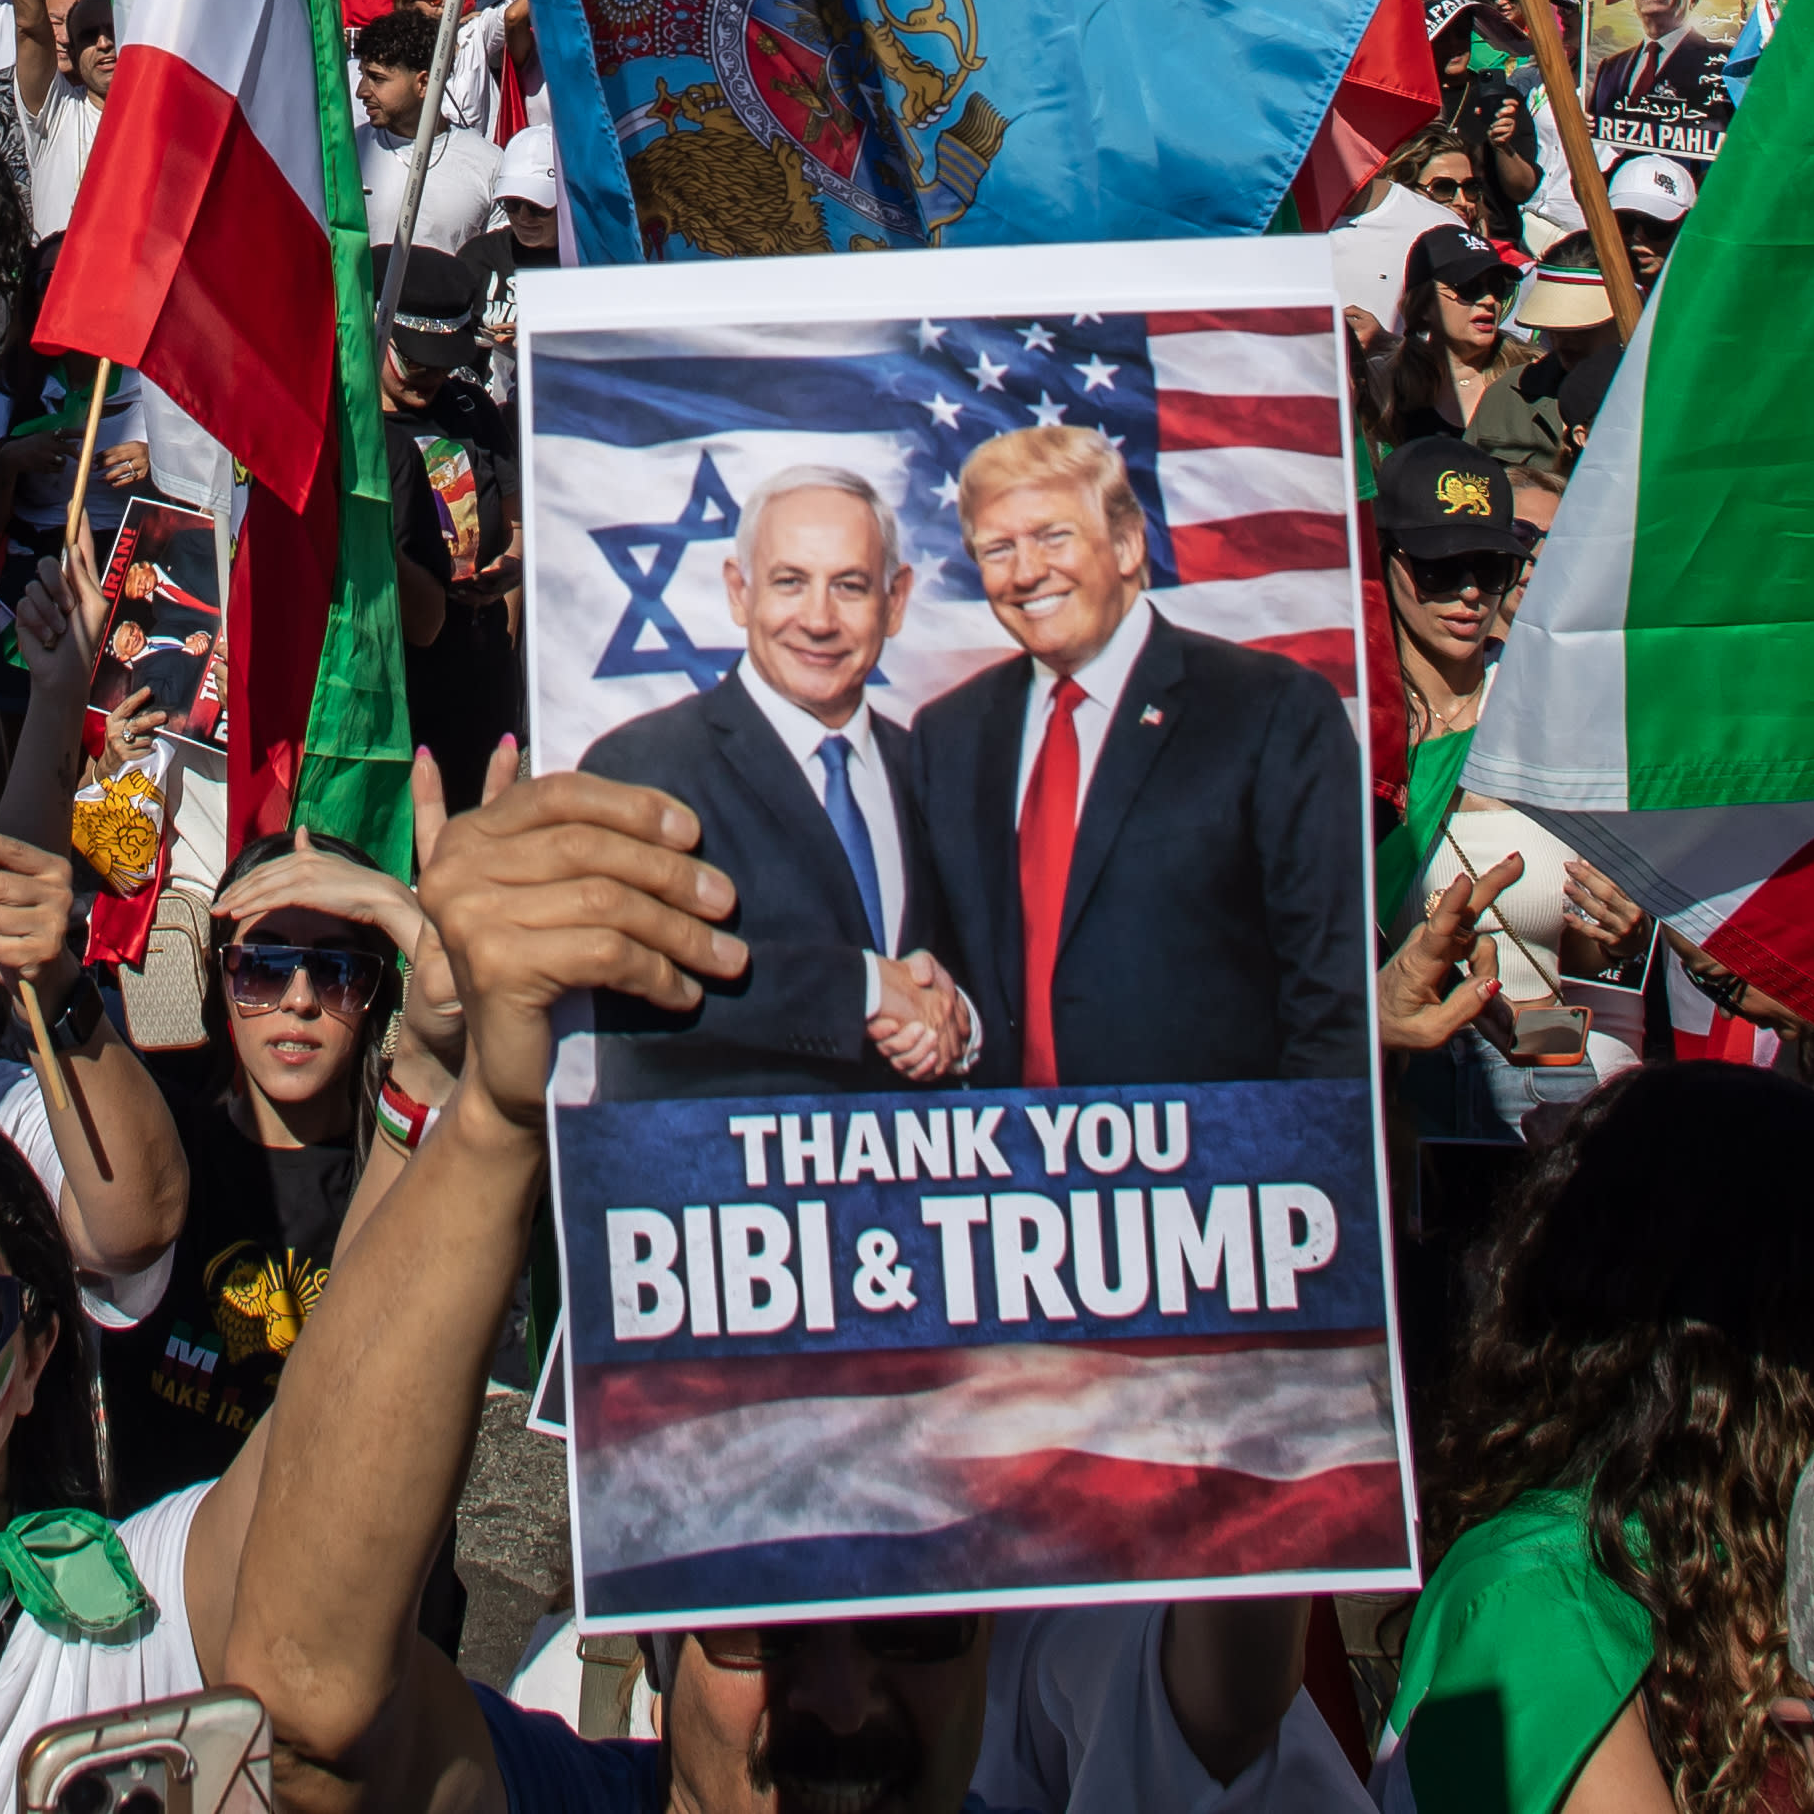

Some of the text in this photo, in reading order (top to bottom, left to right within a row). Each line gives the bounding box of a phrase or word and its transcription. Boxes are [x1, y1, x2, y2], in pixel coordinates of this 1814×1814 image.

[1705, 53, 1728, 66] هبر
[1599, 117, 1727, 154] REZA PAHL
[1460, 233, 1489, 252] LA
[102, 526, 136, 599] IRAN!
[728, 1100, 1190, 1187] THANK YOU
[605, 1183, 1338, 1342] BIBI & TRUMP
[151, 1369, 256, 1433] MAKE IRA
